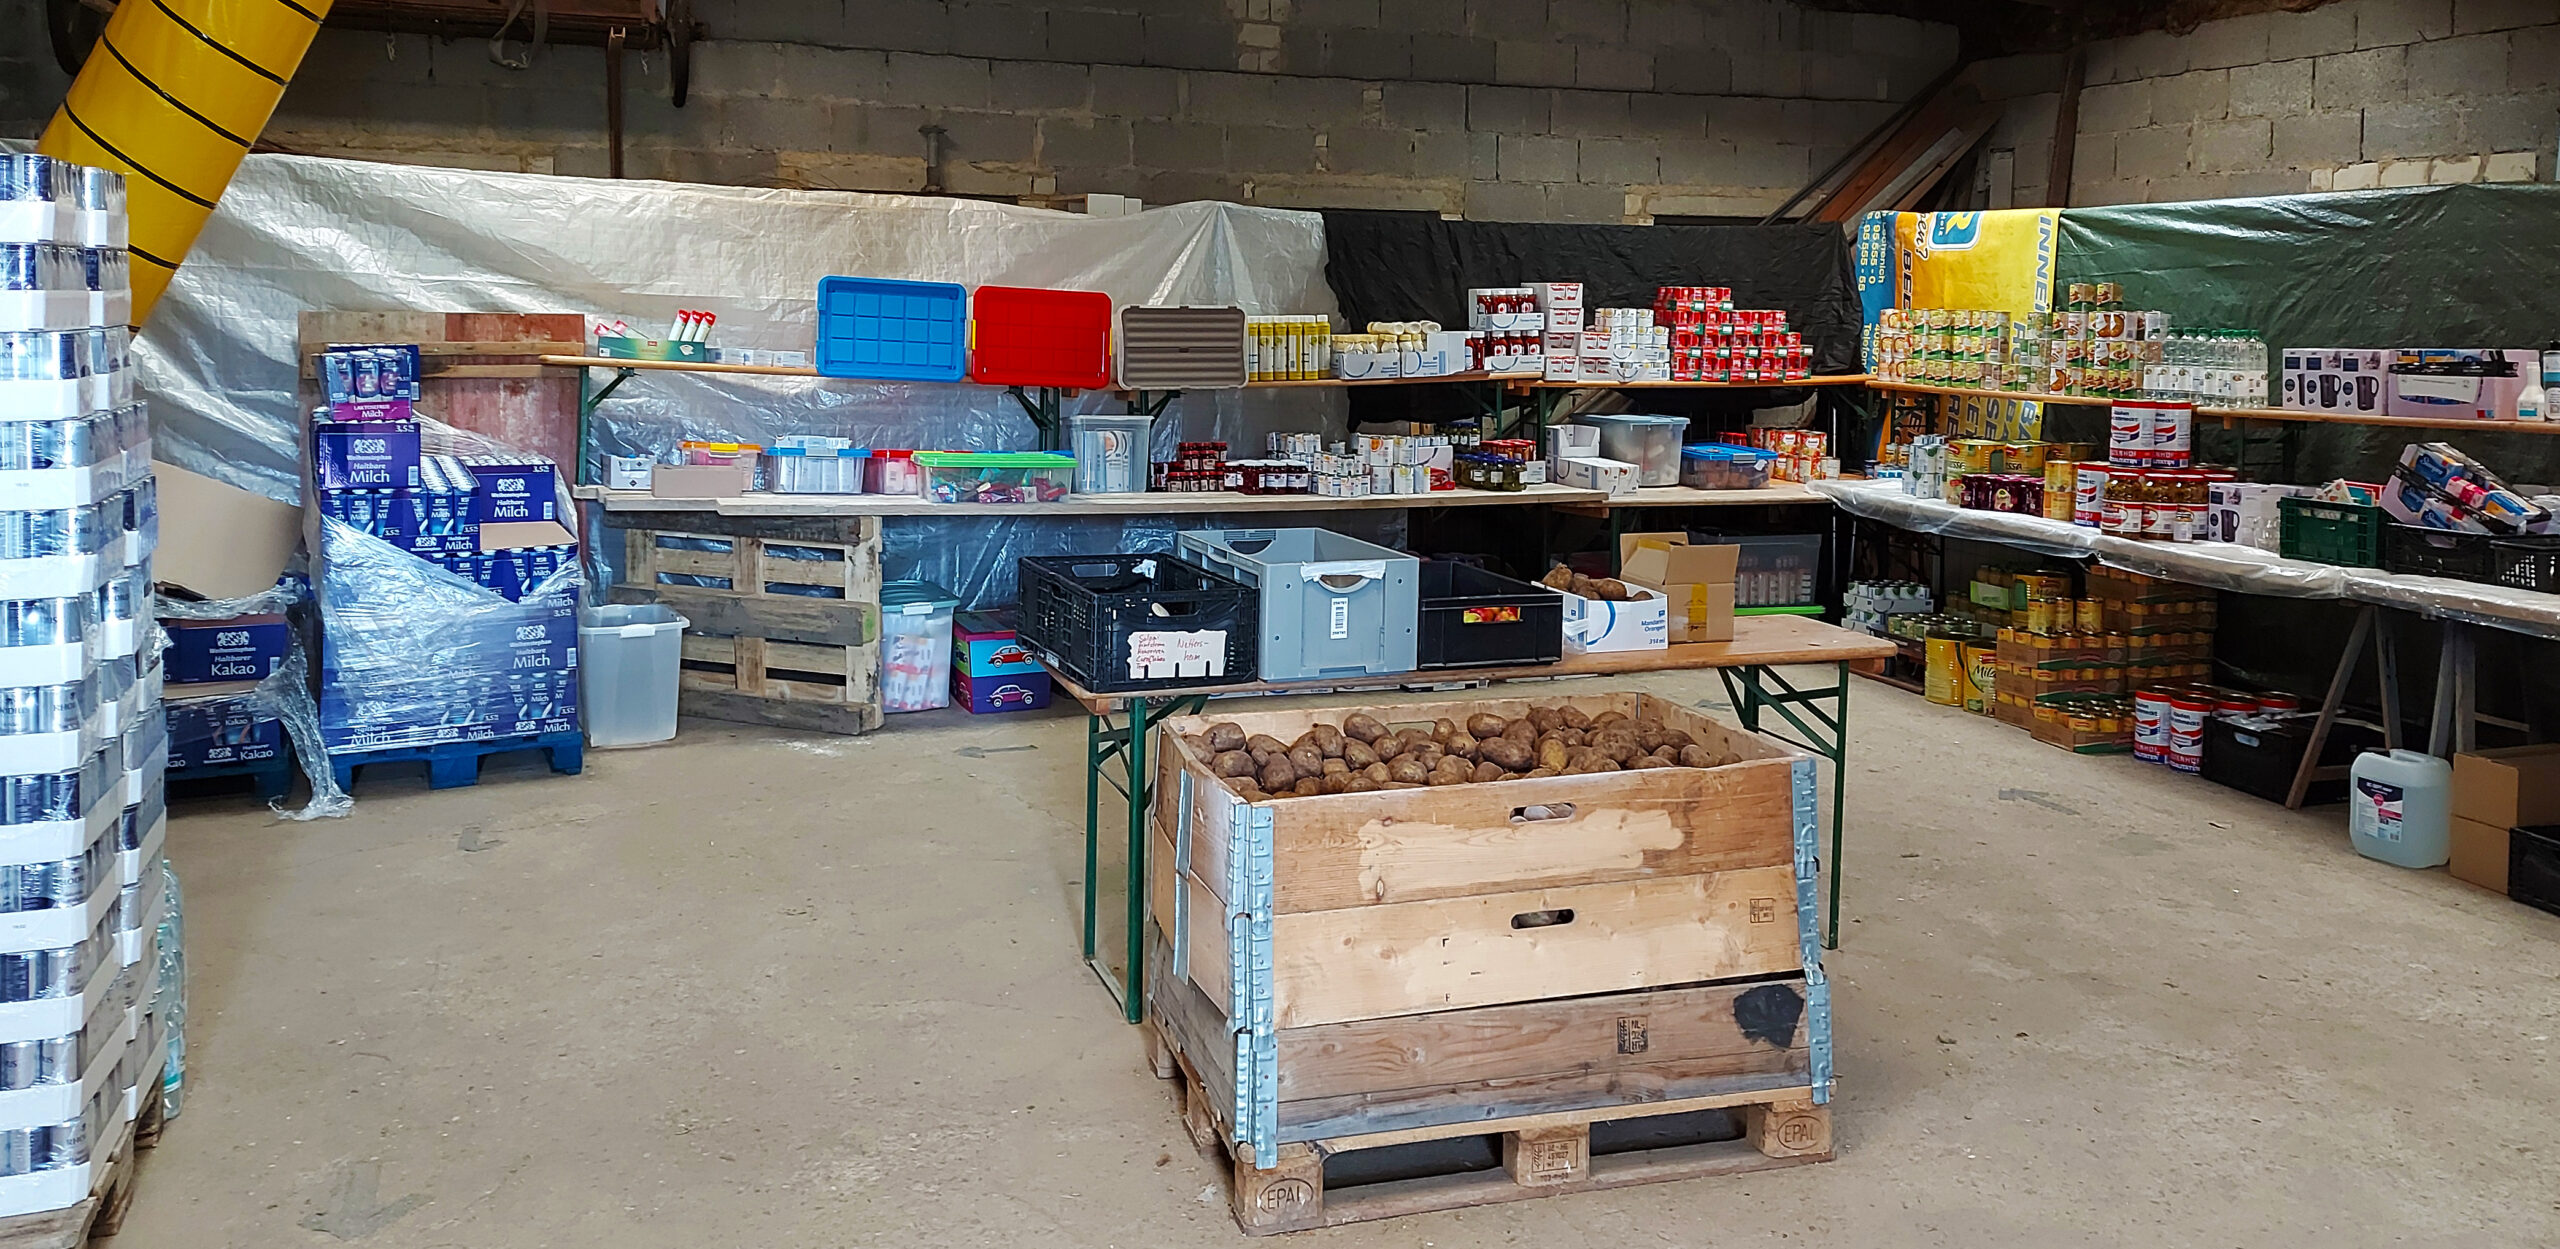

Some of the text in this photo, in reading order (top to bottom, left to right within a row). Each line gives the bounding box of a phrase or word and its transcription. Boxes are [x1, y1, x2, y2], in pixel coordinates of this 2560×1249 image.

[1860, 242, 1869, 266] 555
[1870, 243, 1879, 266] 555
[361, 409, 384, 418] Milch
[353, 462, 387, 470] Haltbare
[349, 469, 391, 483] Milch
[493, 506, 529, 518] Milch
[444, 541, 474, 551] Milch
[532, 569, 551, 577] Milch
[546, 596, 574, 608] Milch
[1649, 637, 1660, 645] 314
[512, 654, 551, 670] Milch
[210, 662, 257, 676] Kakao
[225, 718, 248, 726] Kakao
[543, 722, 571, 733] Milch
[349, 731, 391, 746] Milch
[467, 729, 495, 740] Milch
[239, 749, 274, 760] Kakao
[1784, 1123, 1817, 1143] EPAL
